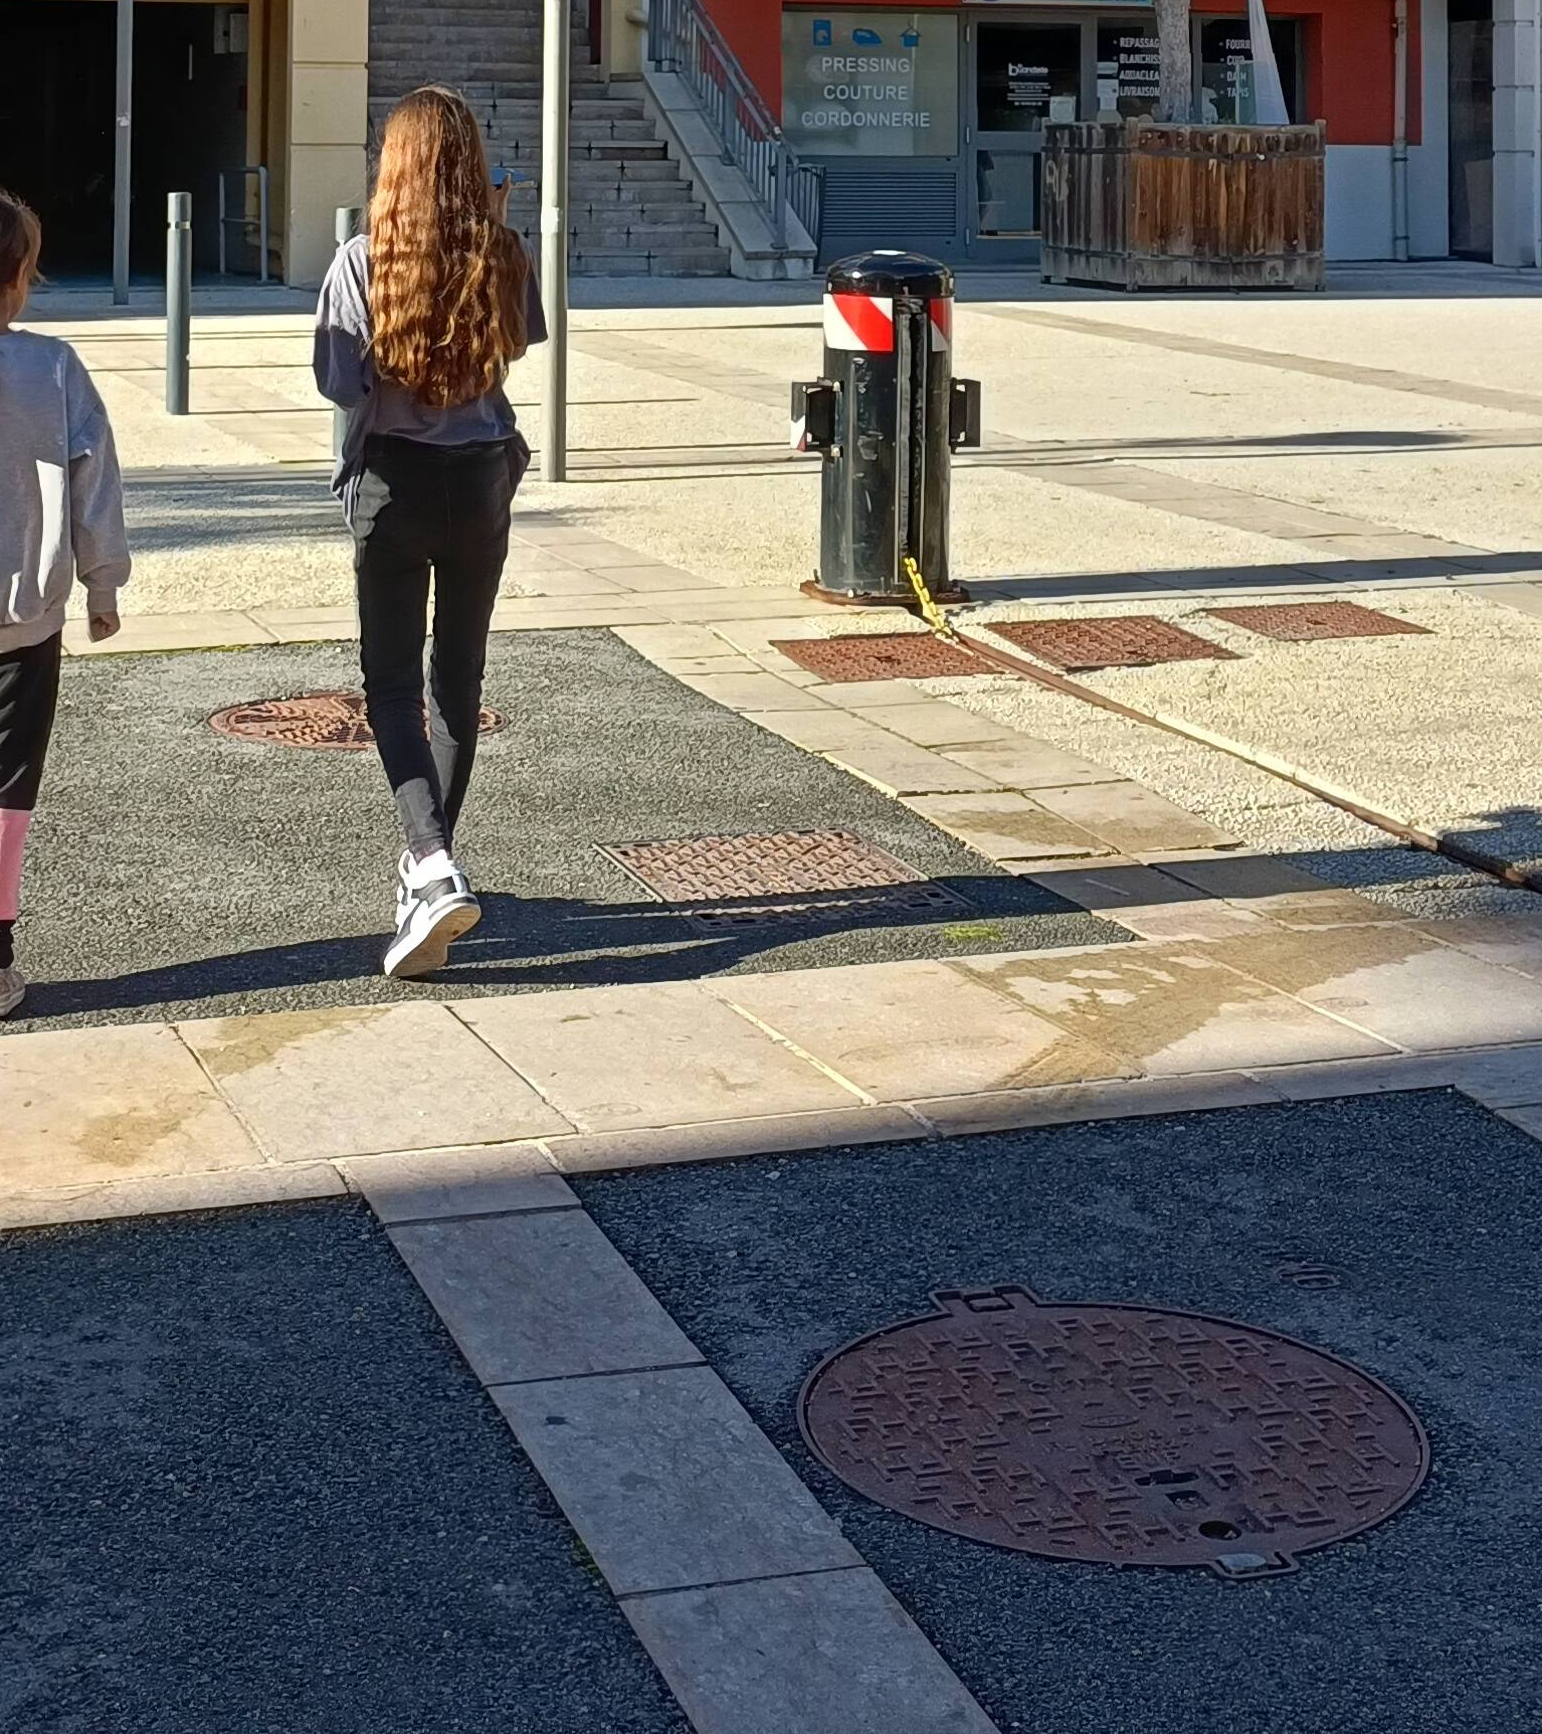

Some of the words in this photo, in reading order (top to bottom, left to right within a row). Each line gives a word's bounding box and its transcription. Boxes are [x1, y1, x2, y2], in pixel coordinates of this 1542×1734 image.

[1119, 37, 1160, 49] REPASSAG
[822, 57, 910, 73] PRESSING
[823, 84, 908, 101] COUTURE
[801, 111, 931, 128] CORDONNERIE
